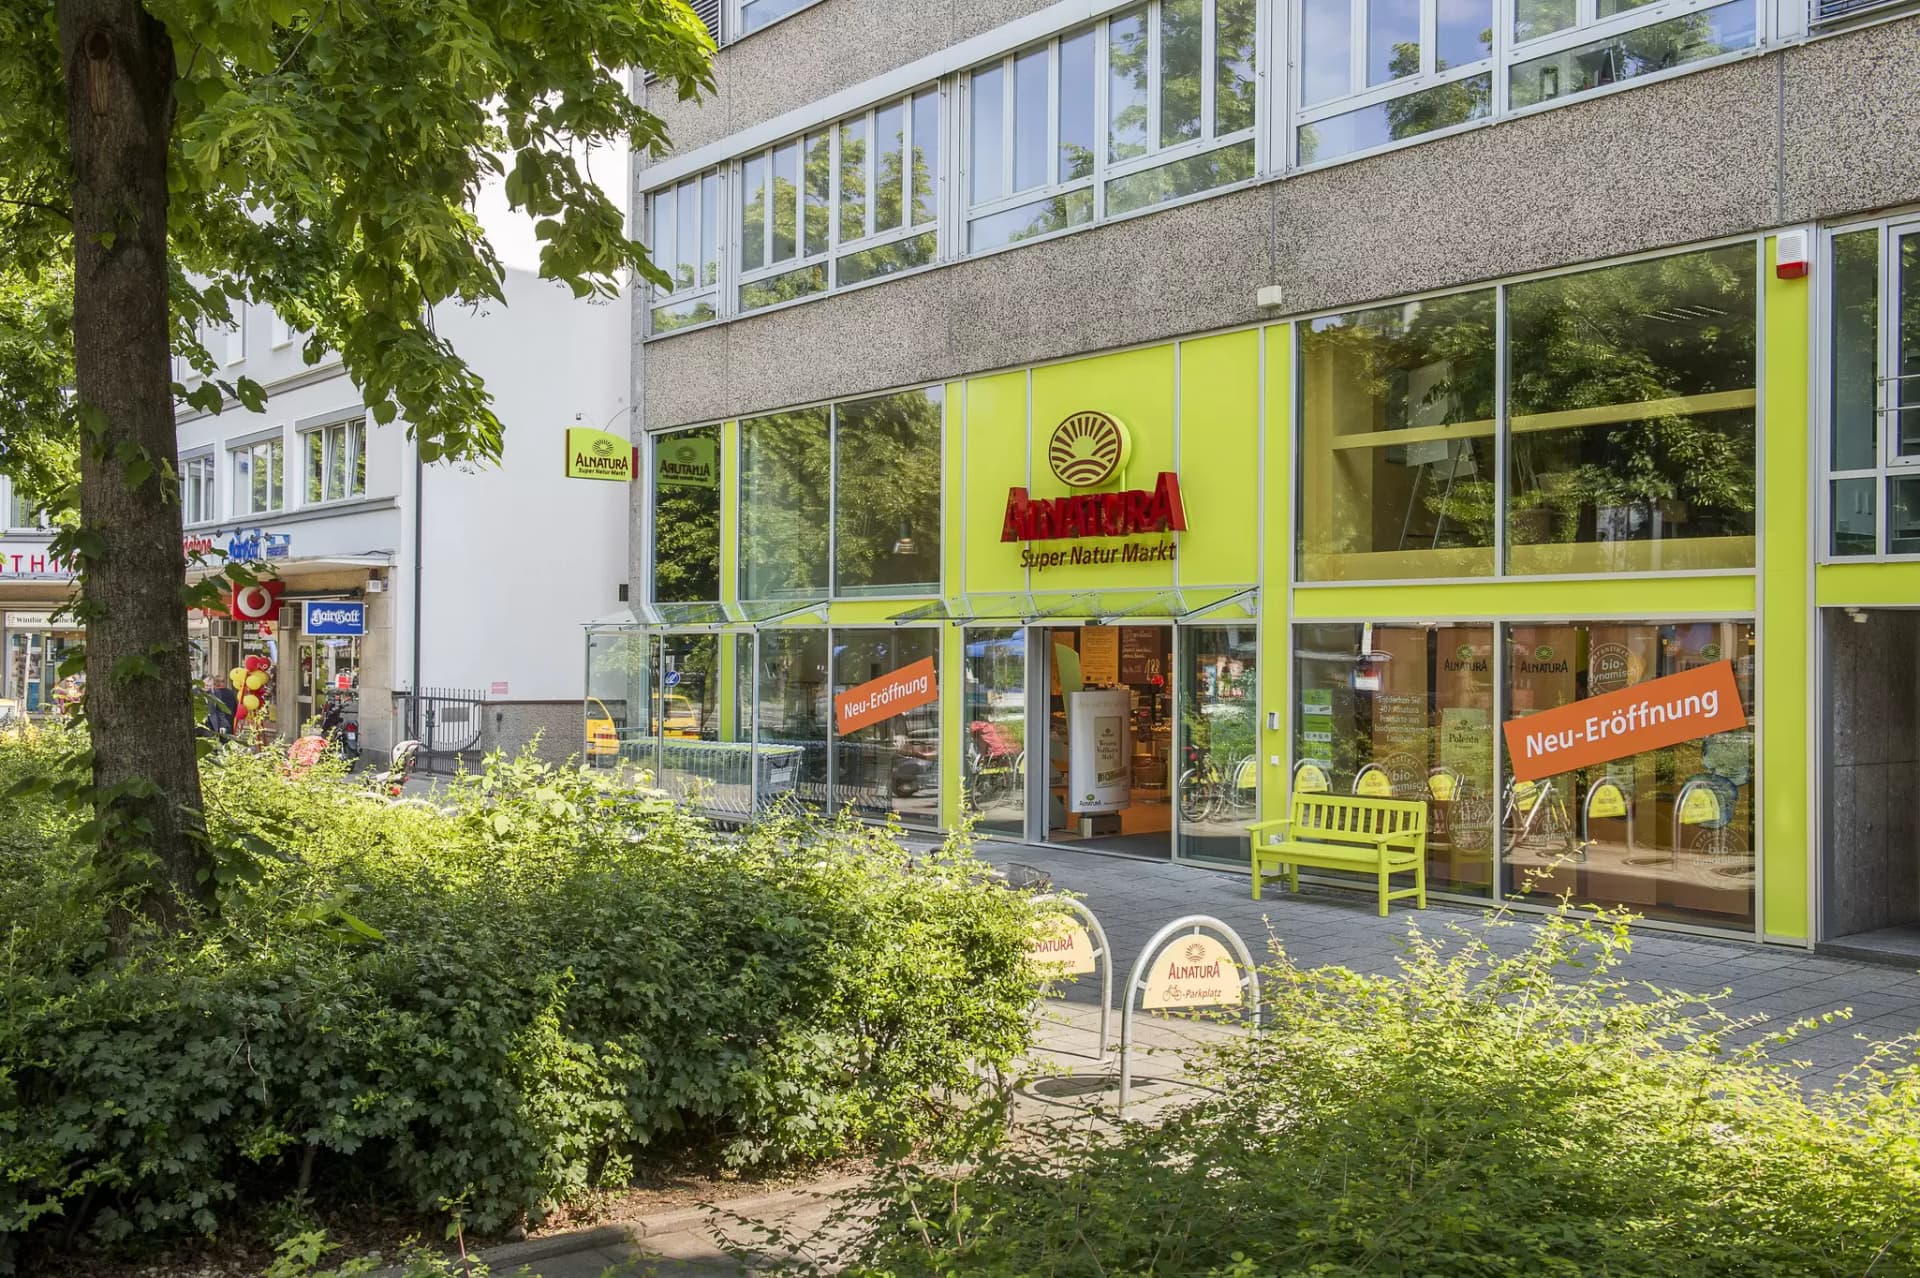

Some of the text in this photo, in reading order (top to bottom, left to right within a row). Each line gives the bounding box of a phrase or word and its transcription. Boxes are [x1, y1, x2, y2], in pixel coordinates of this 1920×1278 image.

[575, 452, 628, 471] ALNATURA
[1000, 471, 1188, 543] ALNATURA
[1020, 539, 1177, 572] Super Natur Markt
[1443, 657, 1488, 672] ALNATURA
[1520, 660, 1569, 673] ALNATURA
[1602, 659, 1625, 671] bio-
[843, 674, 928, 720] Neu-Eröffnung
[1525, 688, 1720, 759] Neu-Eröffnung
[1168, 960, 1221, 980] ALNATURA
